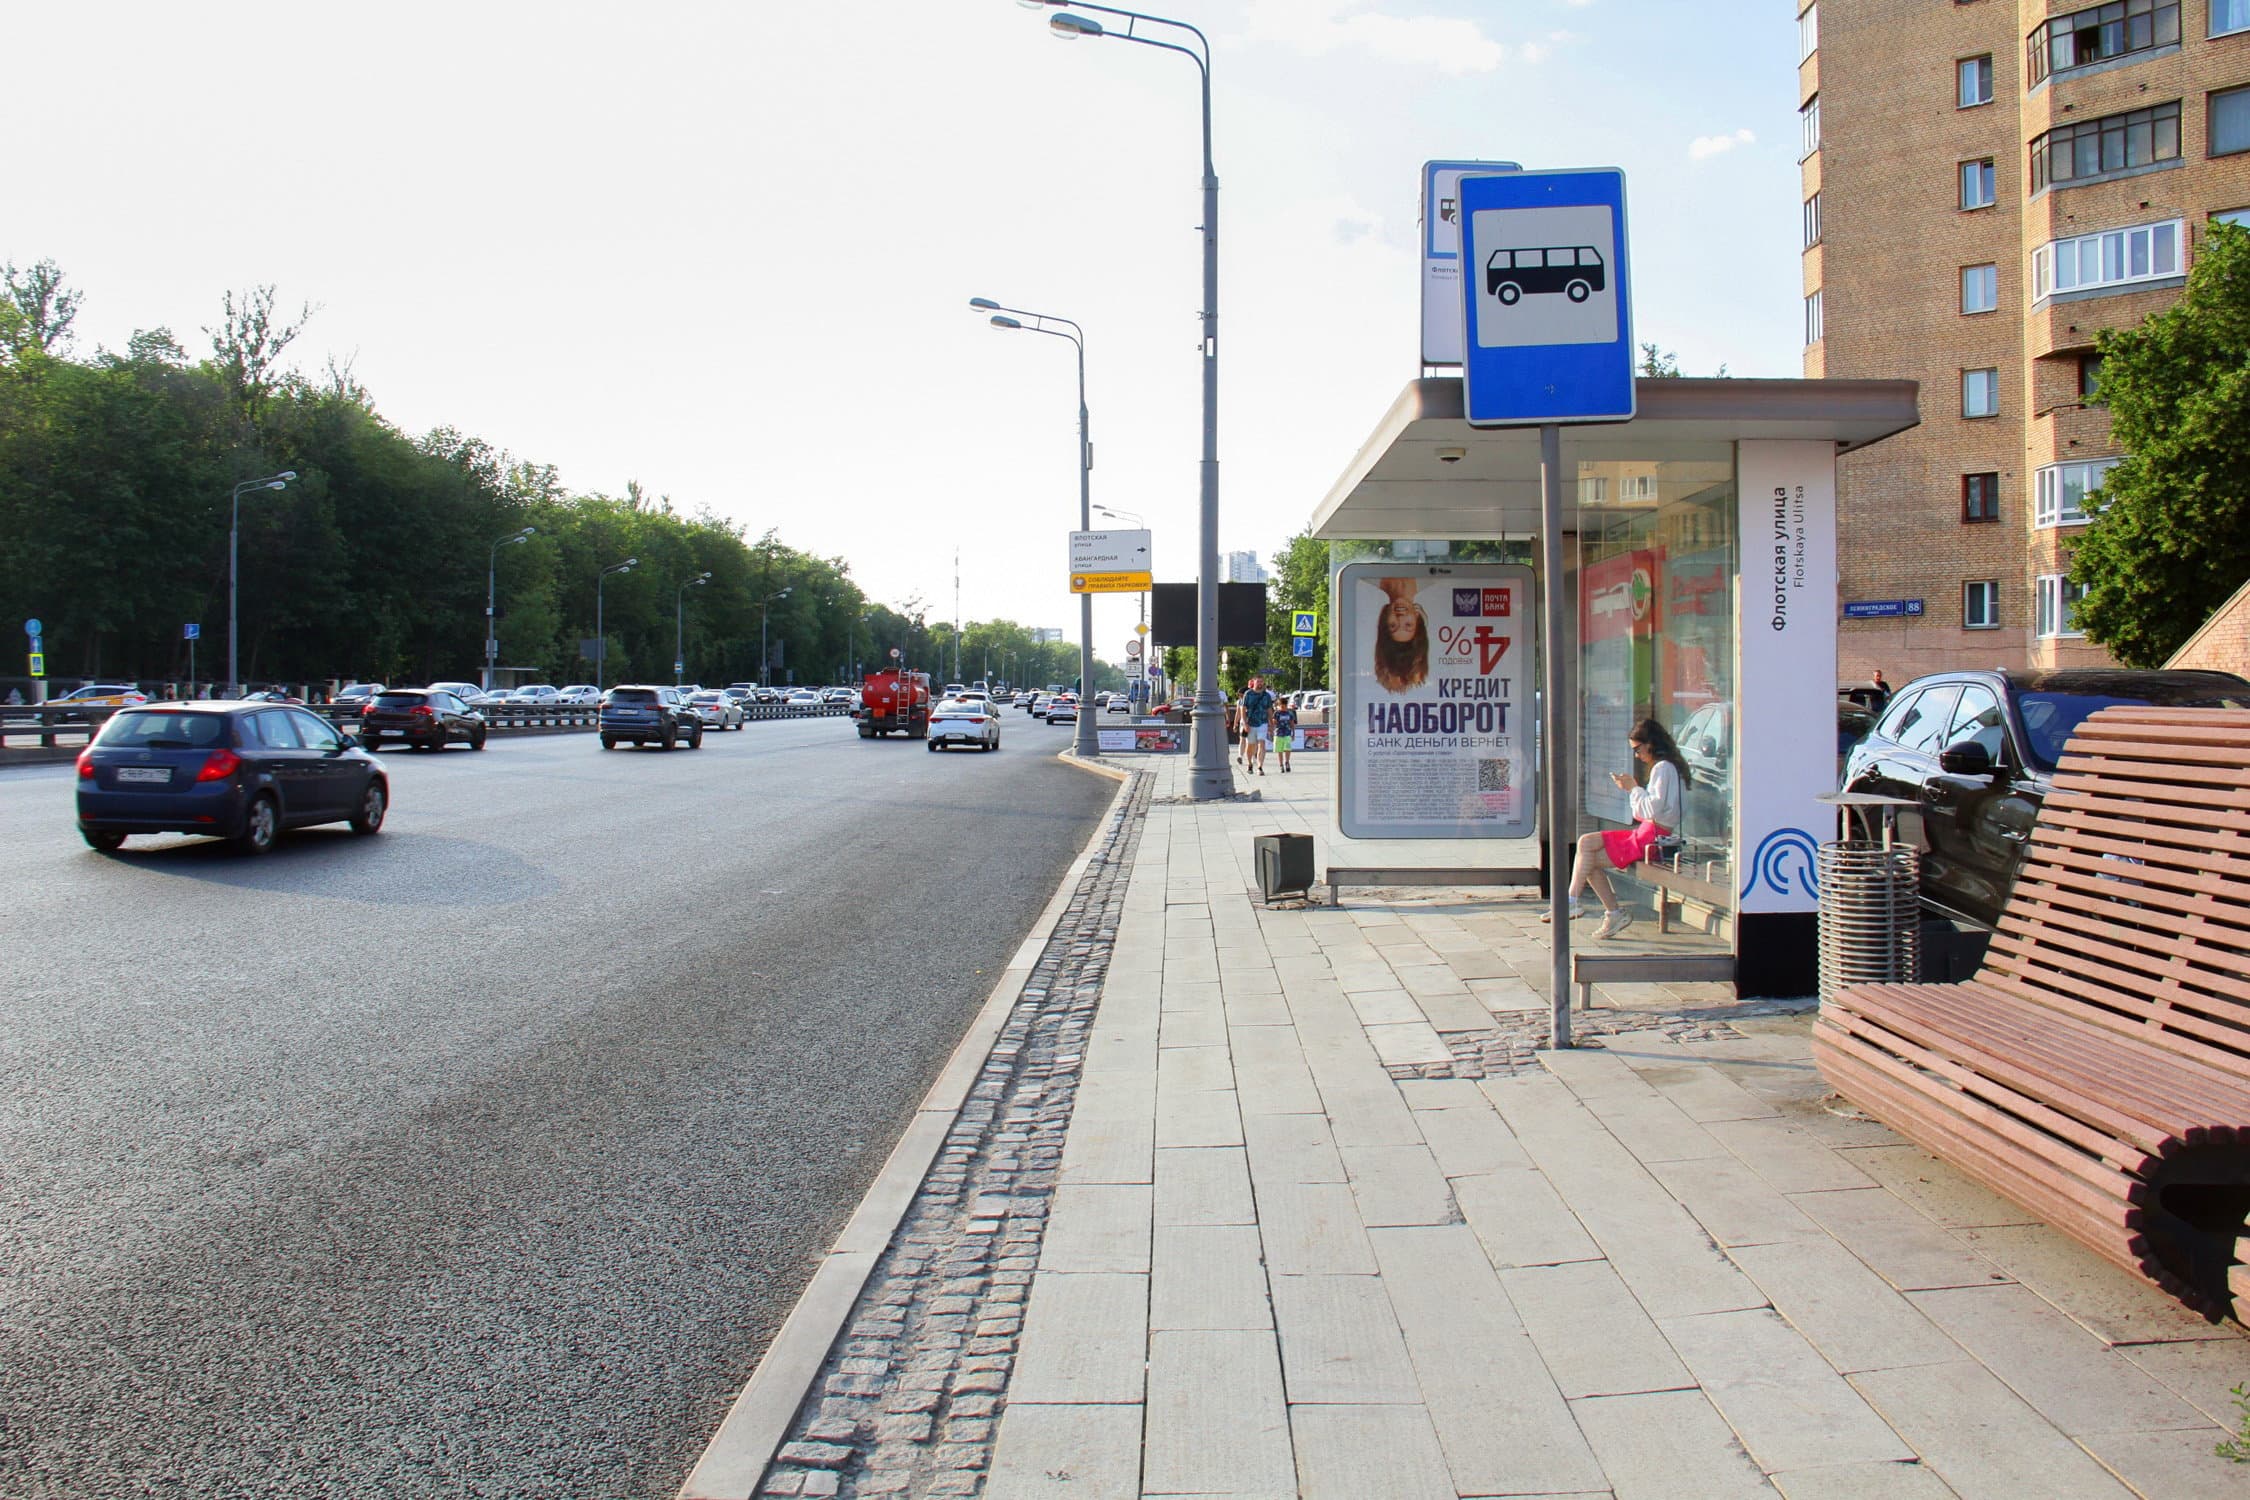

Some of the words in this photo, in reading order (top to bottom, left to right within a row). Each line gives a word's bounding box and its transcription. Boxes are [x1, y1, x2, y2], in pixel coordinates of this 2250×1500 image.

[1774, 486, 1790, 541] улица
[1793, 485, 1805, 524] Ulitsa
[1793, 527, 1806, 589] Flotskaya
[1484, 594, 1508, 602] ПОЧТА
[1771, 545, 1787, 632] Флотская
[1908, 602, 1920, 612] 88
[1438, 678, 1511, 700] КРЕДИТ
[1368, 702, 1511, 734] НАОБОРОТ
[1367, 738, 1402, 748] БАНК
[1404, 738, 1457, 749] ДЕНЬГИ
